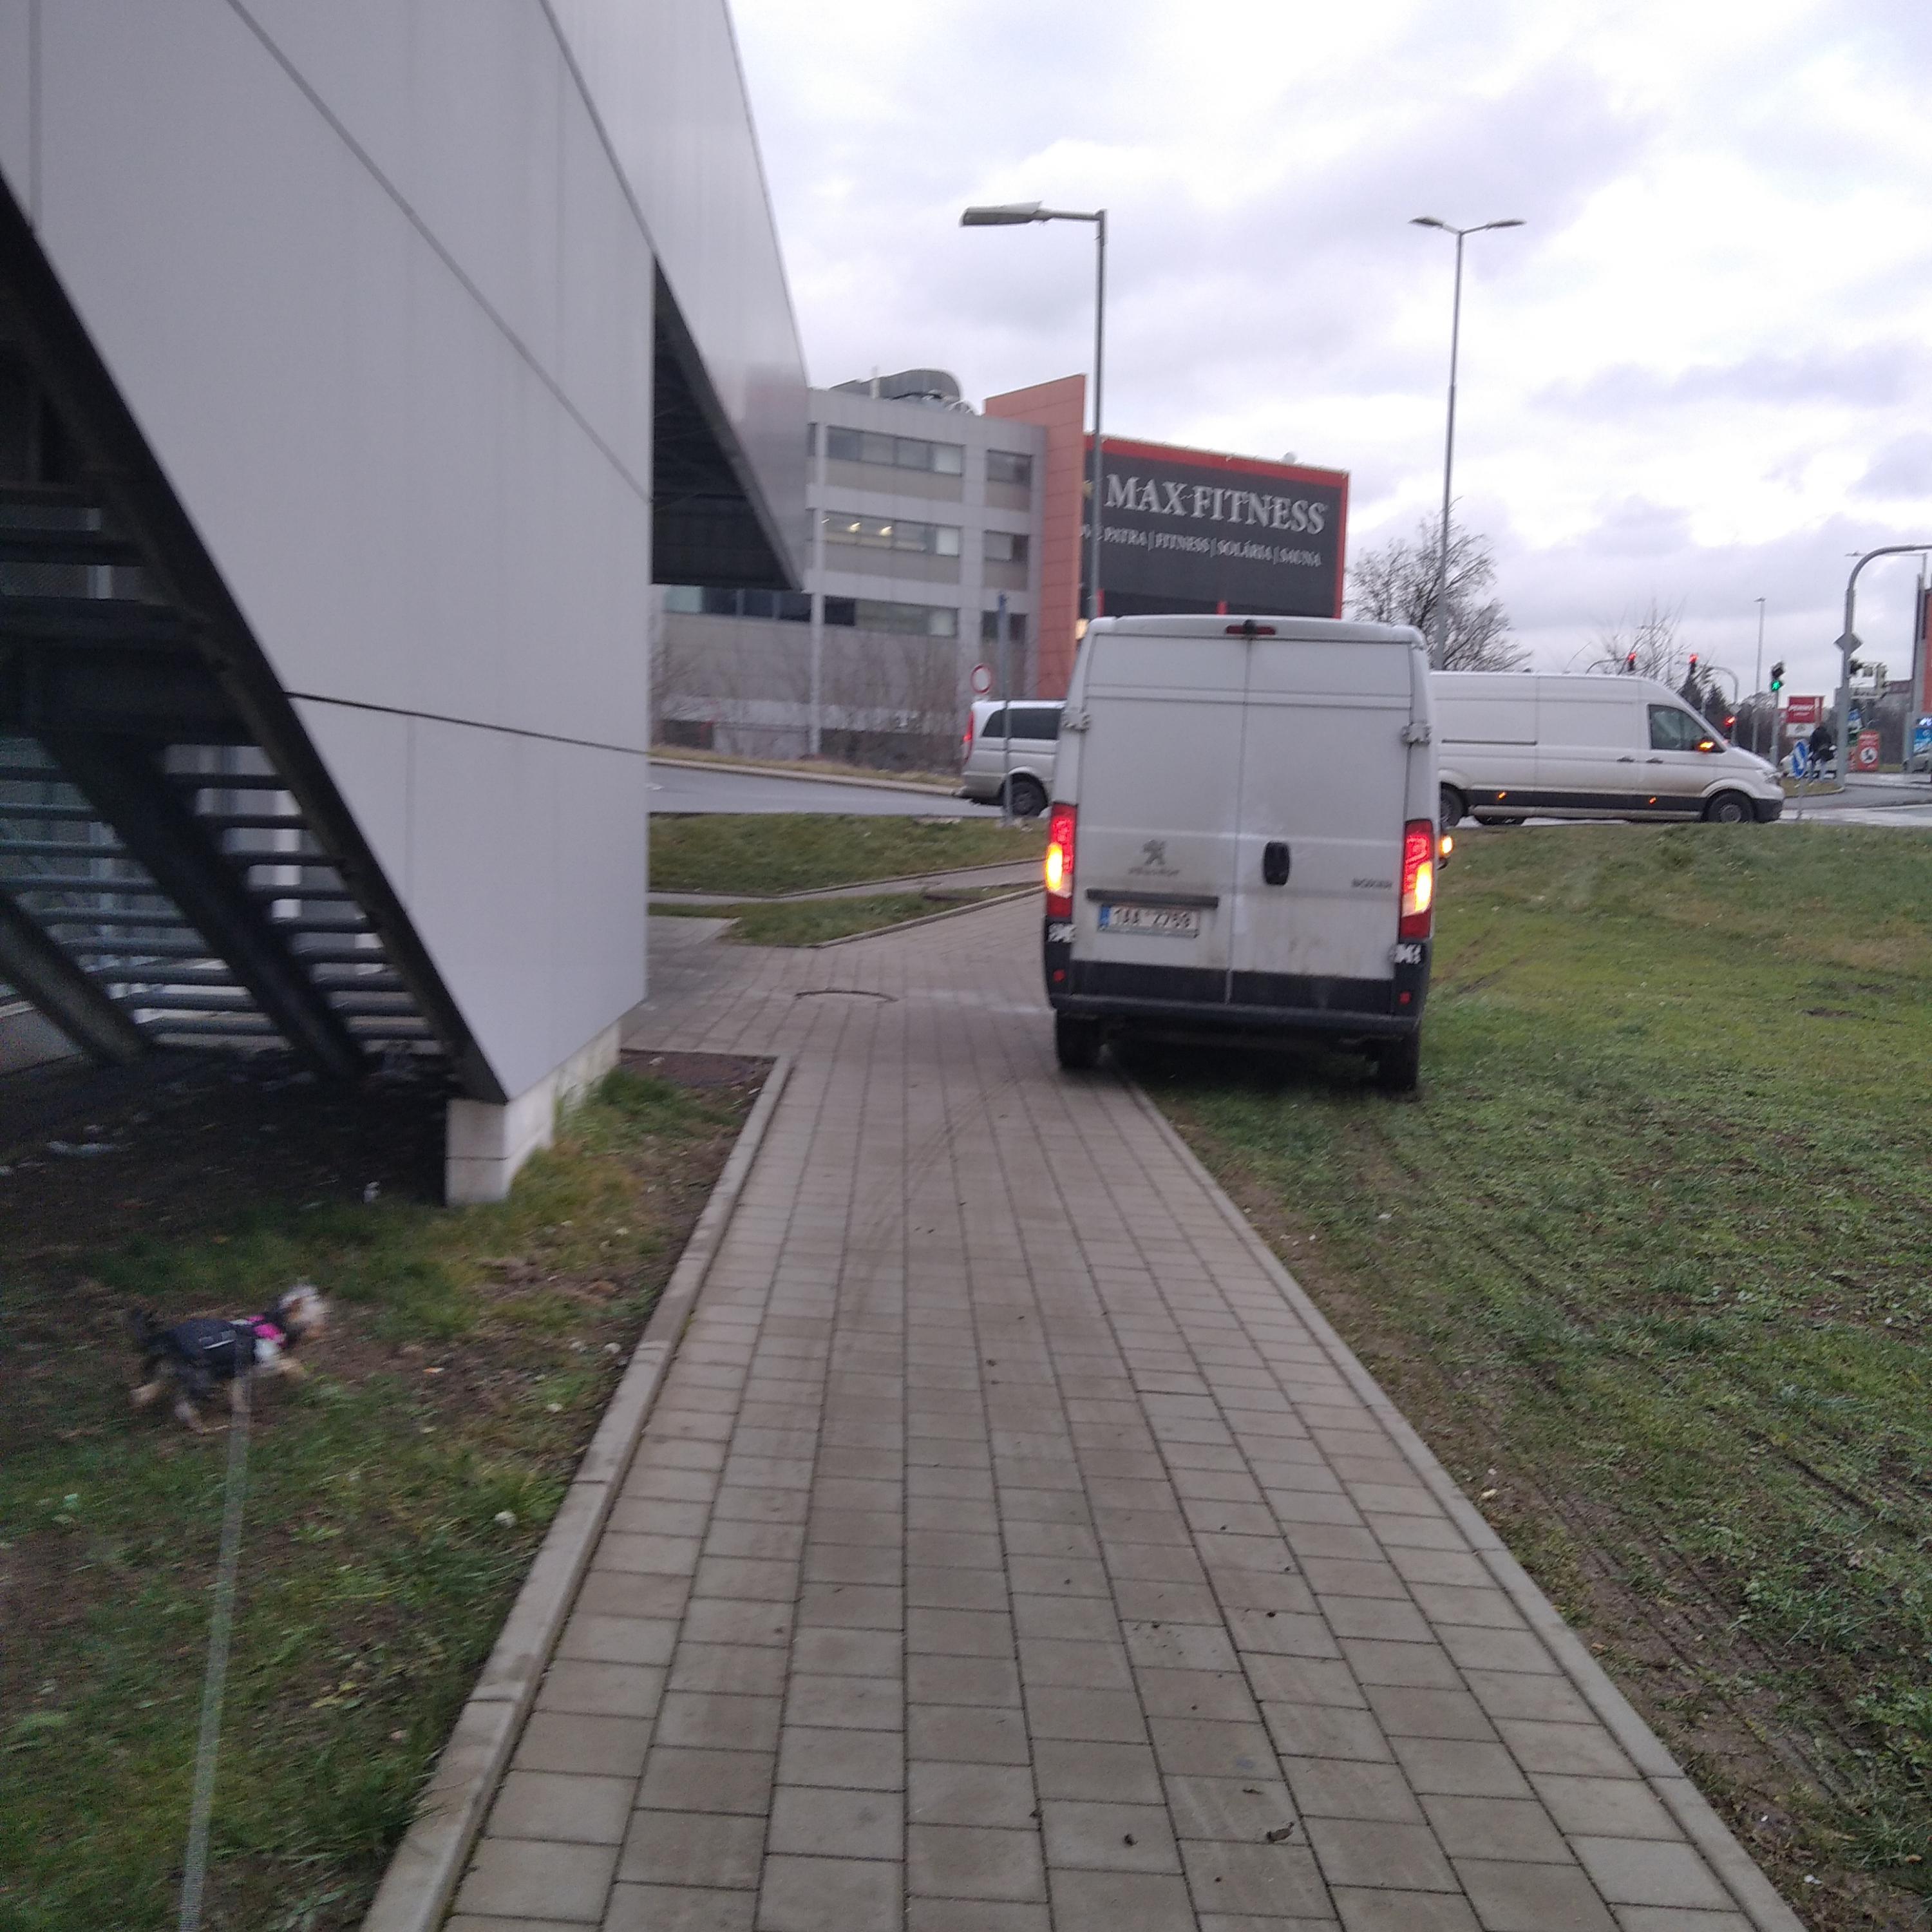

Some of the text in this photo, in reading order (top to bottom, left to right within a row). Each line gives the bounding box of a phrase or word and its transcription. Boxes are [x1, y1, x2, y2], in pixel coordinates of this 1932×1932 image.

[1104, 474, 1328, 535] MAX FITNESS
[1155, 533, 1211, 553] FITNESS
